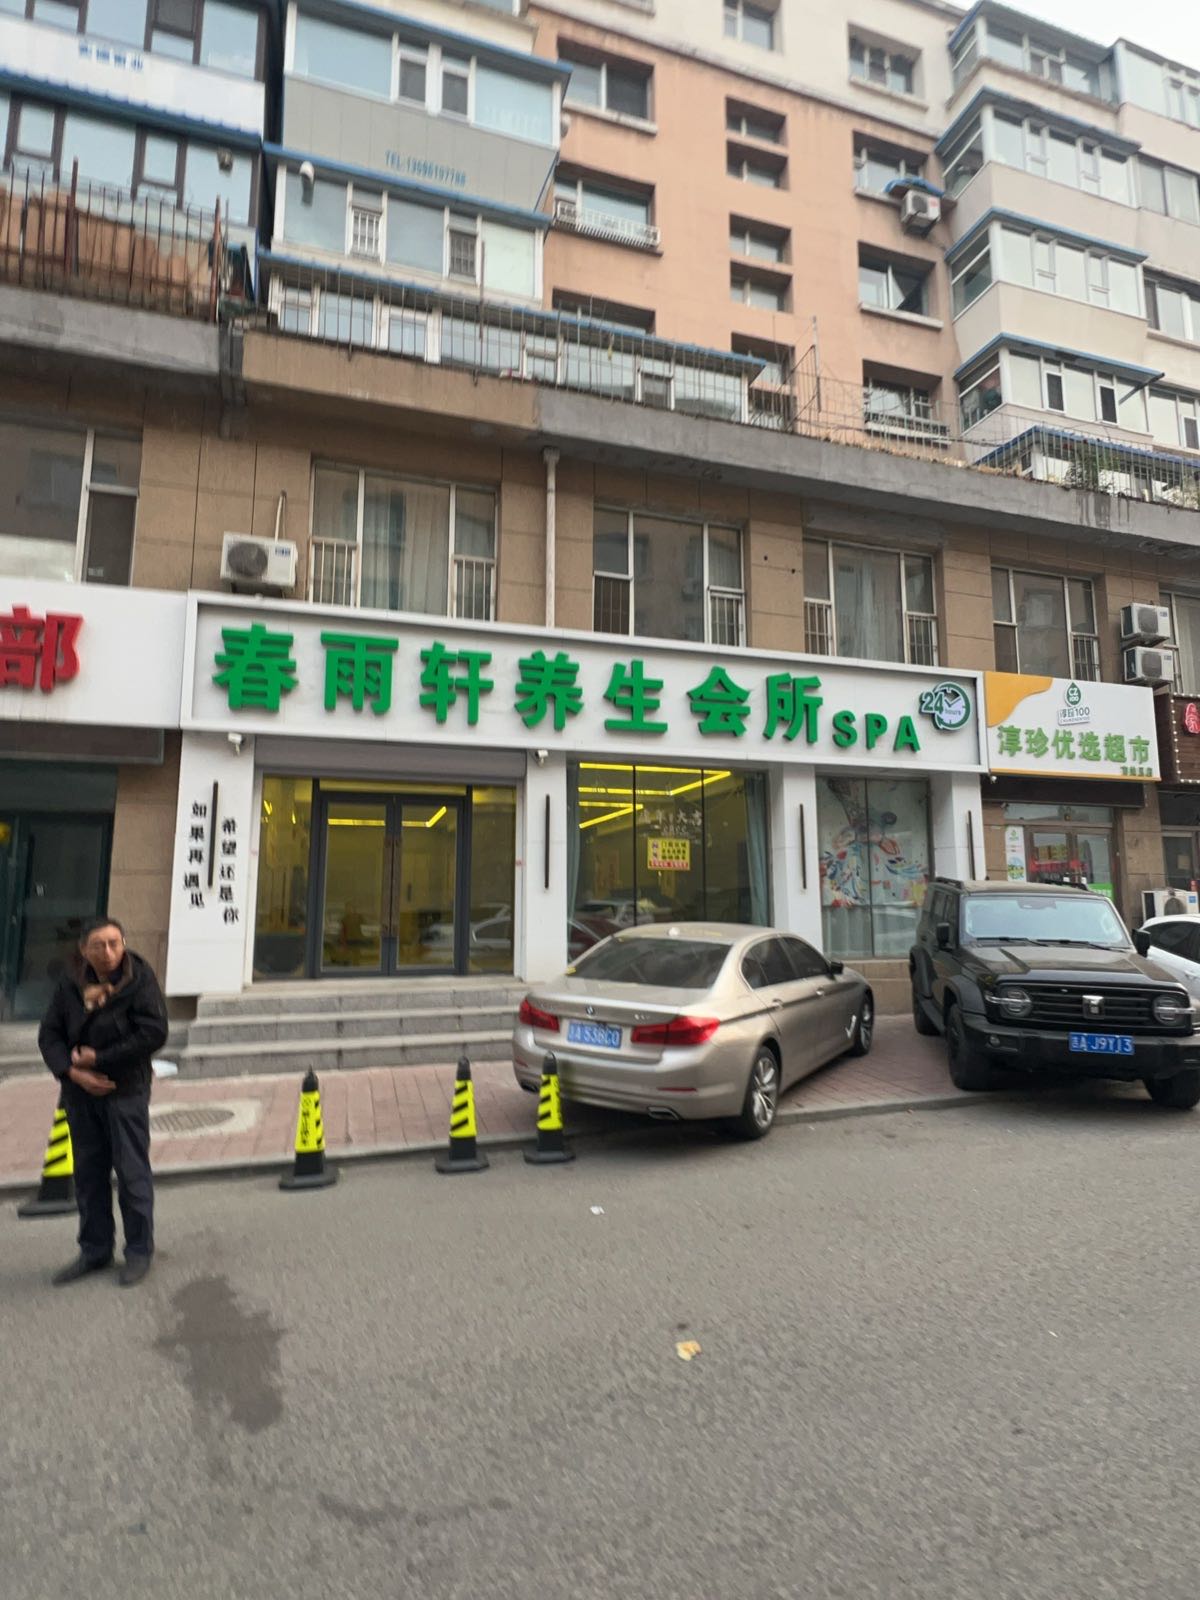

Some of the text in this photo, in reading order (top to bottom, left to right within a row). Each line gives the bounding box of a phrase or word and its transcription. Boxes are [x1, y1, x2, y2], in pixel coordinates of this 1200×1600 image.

[0, 606, 83, 693] 部
[212, 622, 921, 757] 春雨轩养生会所 SPA
[919, 690, 945, 714] 24
[997, 724, 1151, 764] 淳珍优选超市
[184, 800, 208, 908] 如果再遇见
[218, 817, 240, 925] 希望还是你
